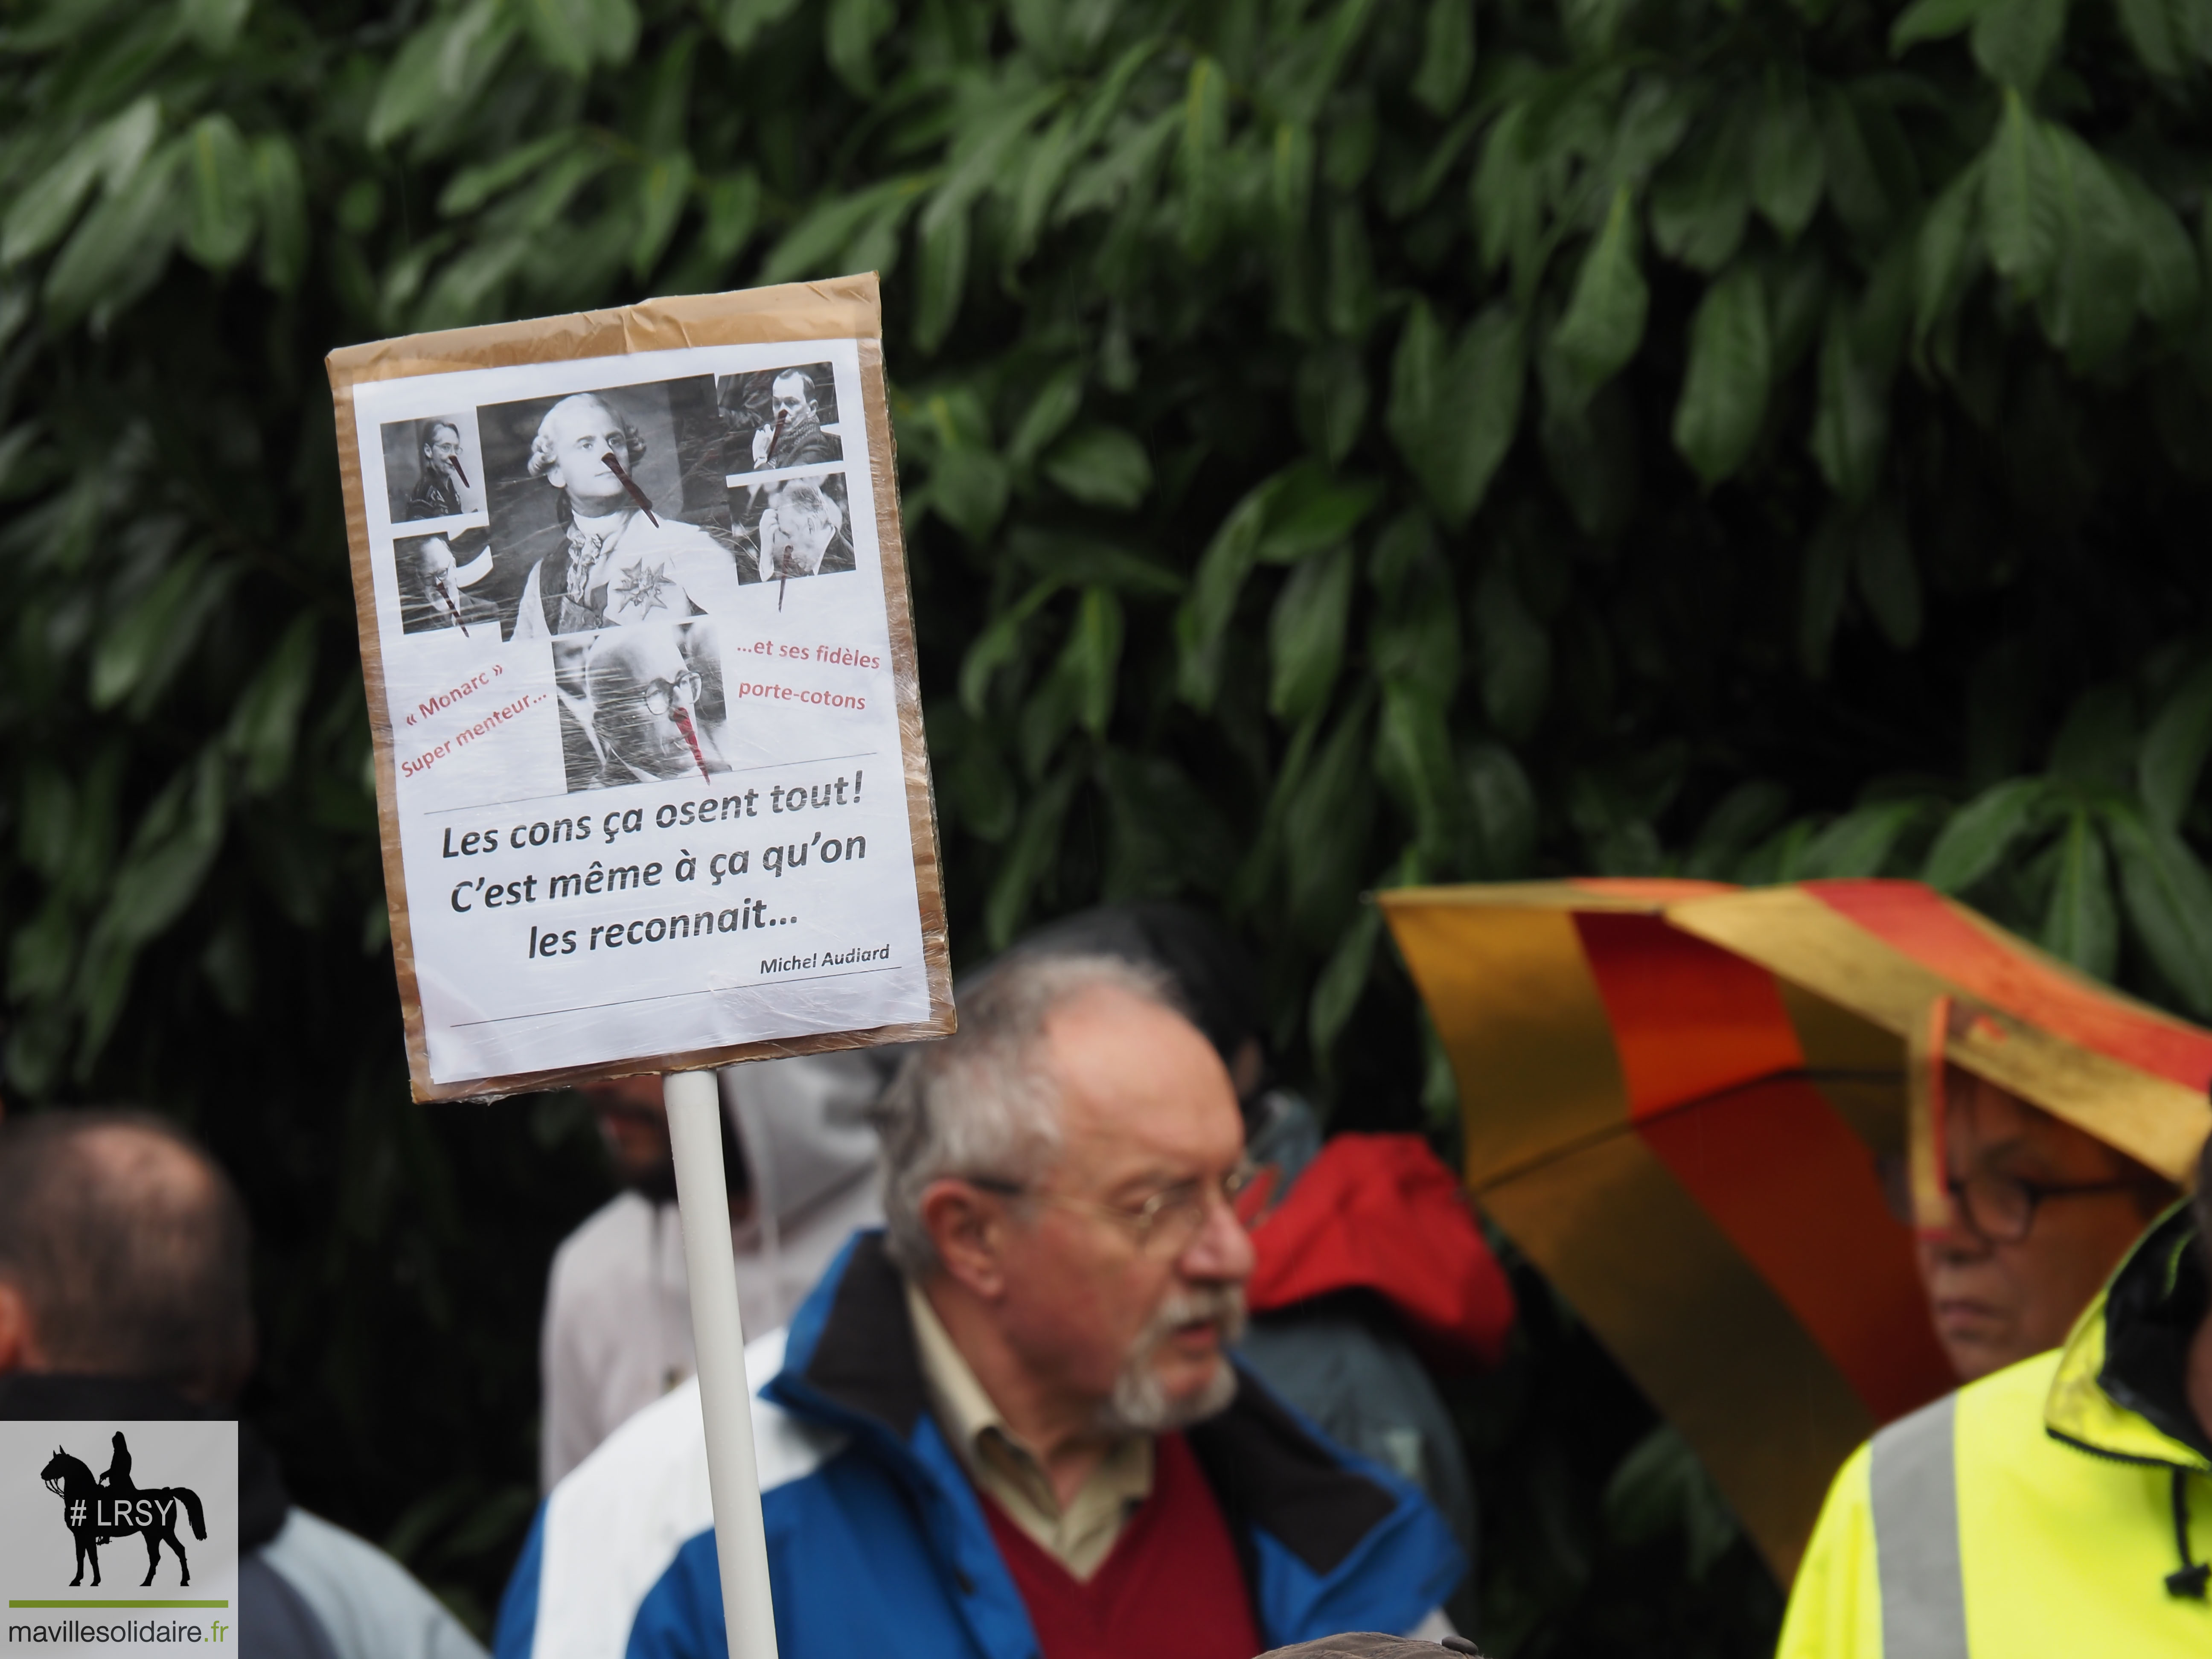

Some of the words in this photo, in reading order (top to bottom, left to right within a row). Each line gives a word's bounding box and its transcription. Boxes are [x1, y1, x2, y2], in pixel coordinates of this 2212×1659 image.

[779, 645, 809, 660] ses
[816, 645, 880, 669] fidèles
[419, 672, 489, 719] Monarc
[739, 682, 865, 710] porte-cotons
[402, 741, 450, 777] Super
[443, 827, 498, 858] Les
[510, 816, 591, 849] cons
[603, 808, 643, 844] ça
[656, 789, 759, 828] osent
[451, 875, 537, 913] C’est
[549, 861, 663, 899] même
[675, 849, 696, 882] à
[710, 850, 749, 886] ça
[763, 831, 866, 878] qu’on
[529, 926, 576, 959] les
[590, 898, 797, 950] reconnait...
[760, 953, 817, 974] Michel
[821, 943, 890, 968] Audiard
